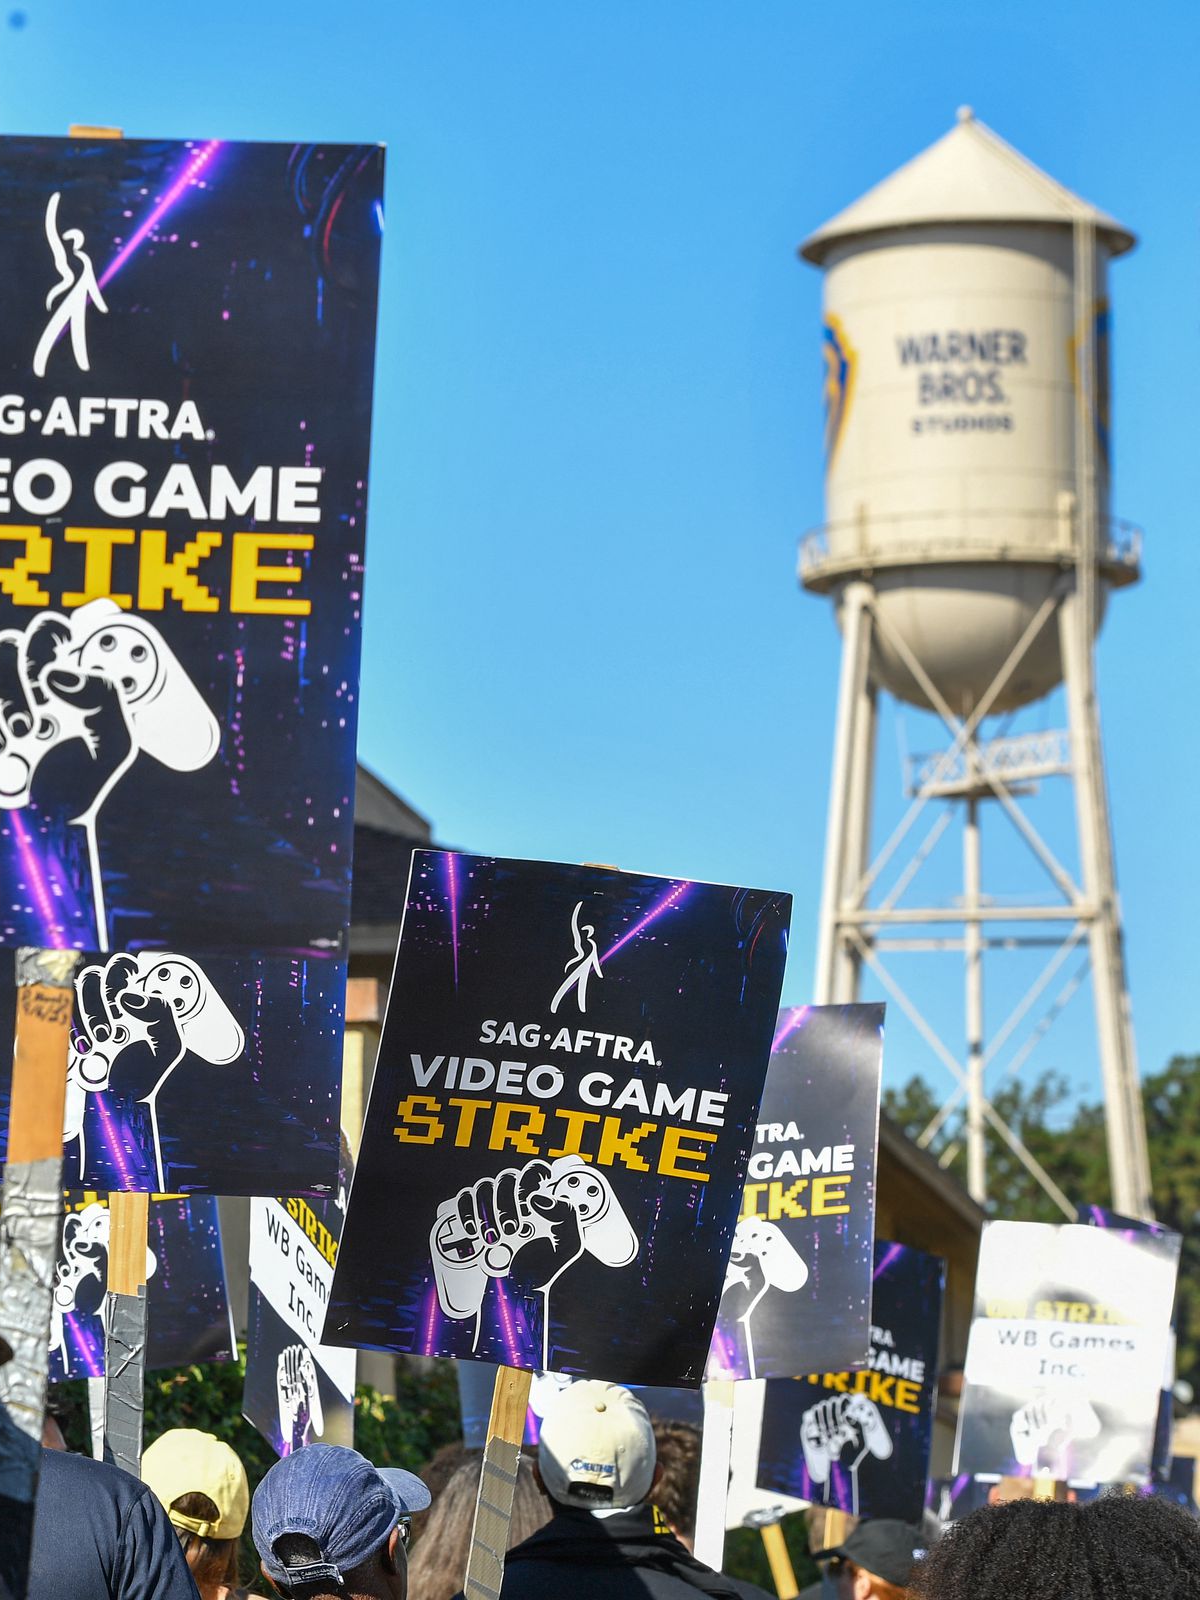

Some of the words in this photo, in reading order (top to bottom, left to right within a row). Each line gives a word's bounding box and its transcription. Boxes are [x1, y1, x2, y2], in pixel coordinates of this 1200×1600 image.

[896, 328, 1029, 366] WARNER
[93, 461, 322, 522] GAME
[410, 1054, 565, 1098] VIDEO
[578, 1072, 729, 1127] GAME
[393, 1095, 718, 1182] STRIKE
[748, 1144, 855, 1180] GAME
[737, 1175, 851, 1222] IKE
[265, 1207, 290, 1257] WB
[295, 1245, 330, 1304] Gam
[286, 1198, 341, 1270] STRIK
[288, 1281, 316, 1338] Inc.
[998, 1330, 1038, 1347] WB
[1049, 1331, 1136, 1351] Games
[1038, 1359, 1086, 1377] Inc.
